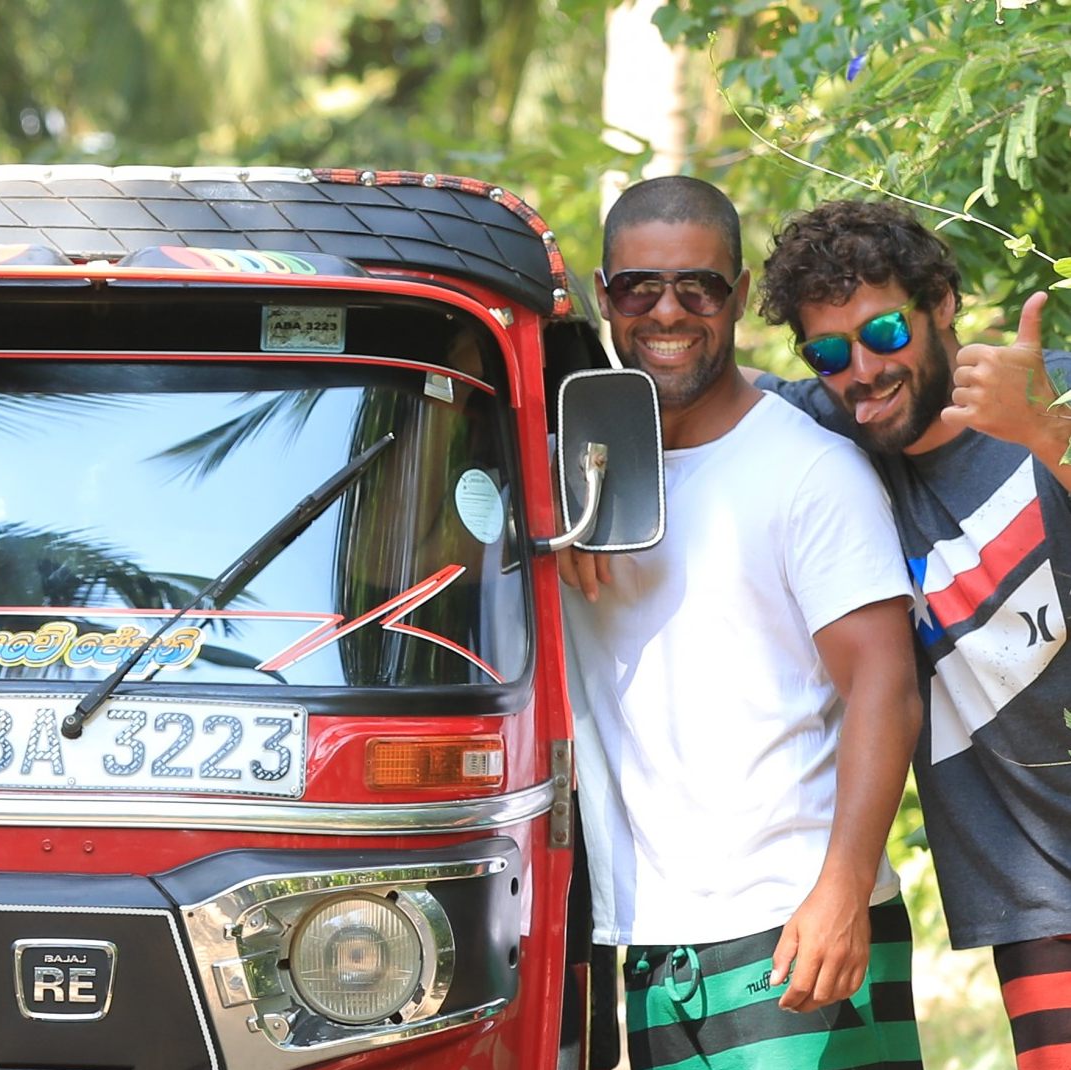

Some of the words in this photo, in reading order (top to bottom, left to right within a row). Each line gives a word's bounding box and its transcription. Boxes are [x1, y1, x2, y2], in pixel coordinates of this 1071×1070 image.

[274, 321, 302, 330] ABA
[305, 321, 338, 331] 3223
[103, 709, 293, 782] 3223
[34, 966, 97, 1003] RE
